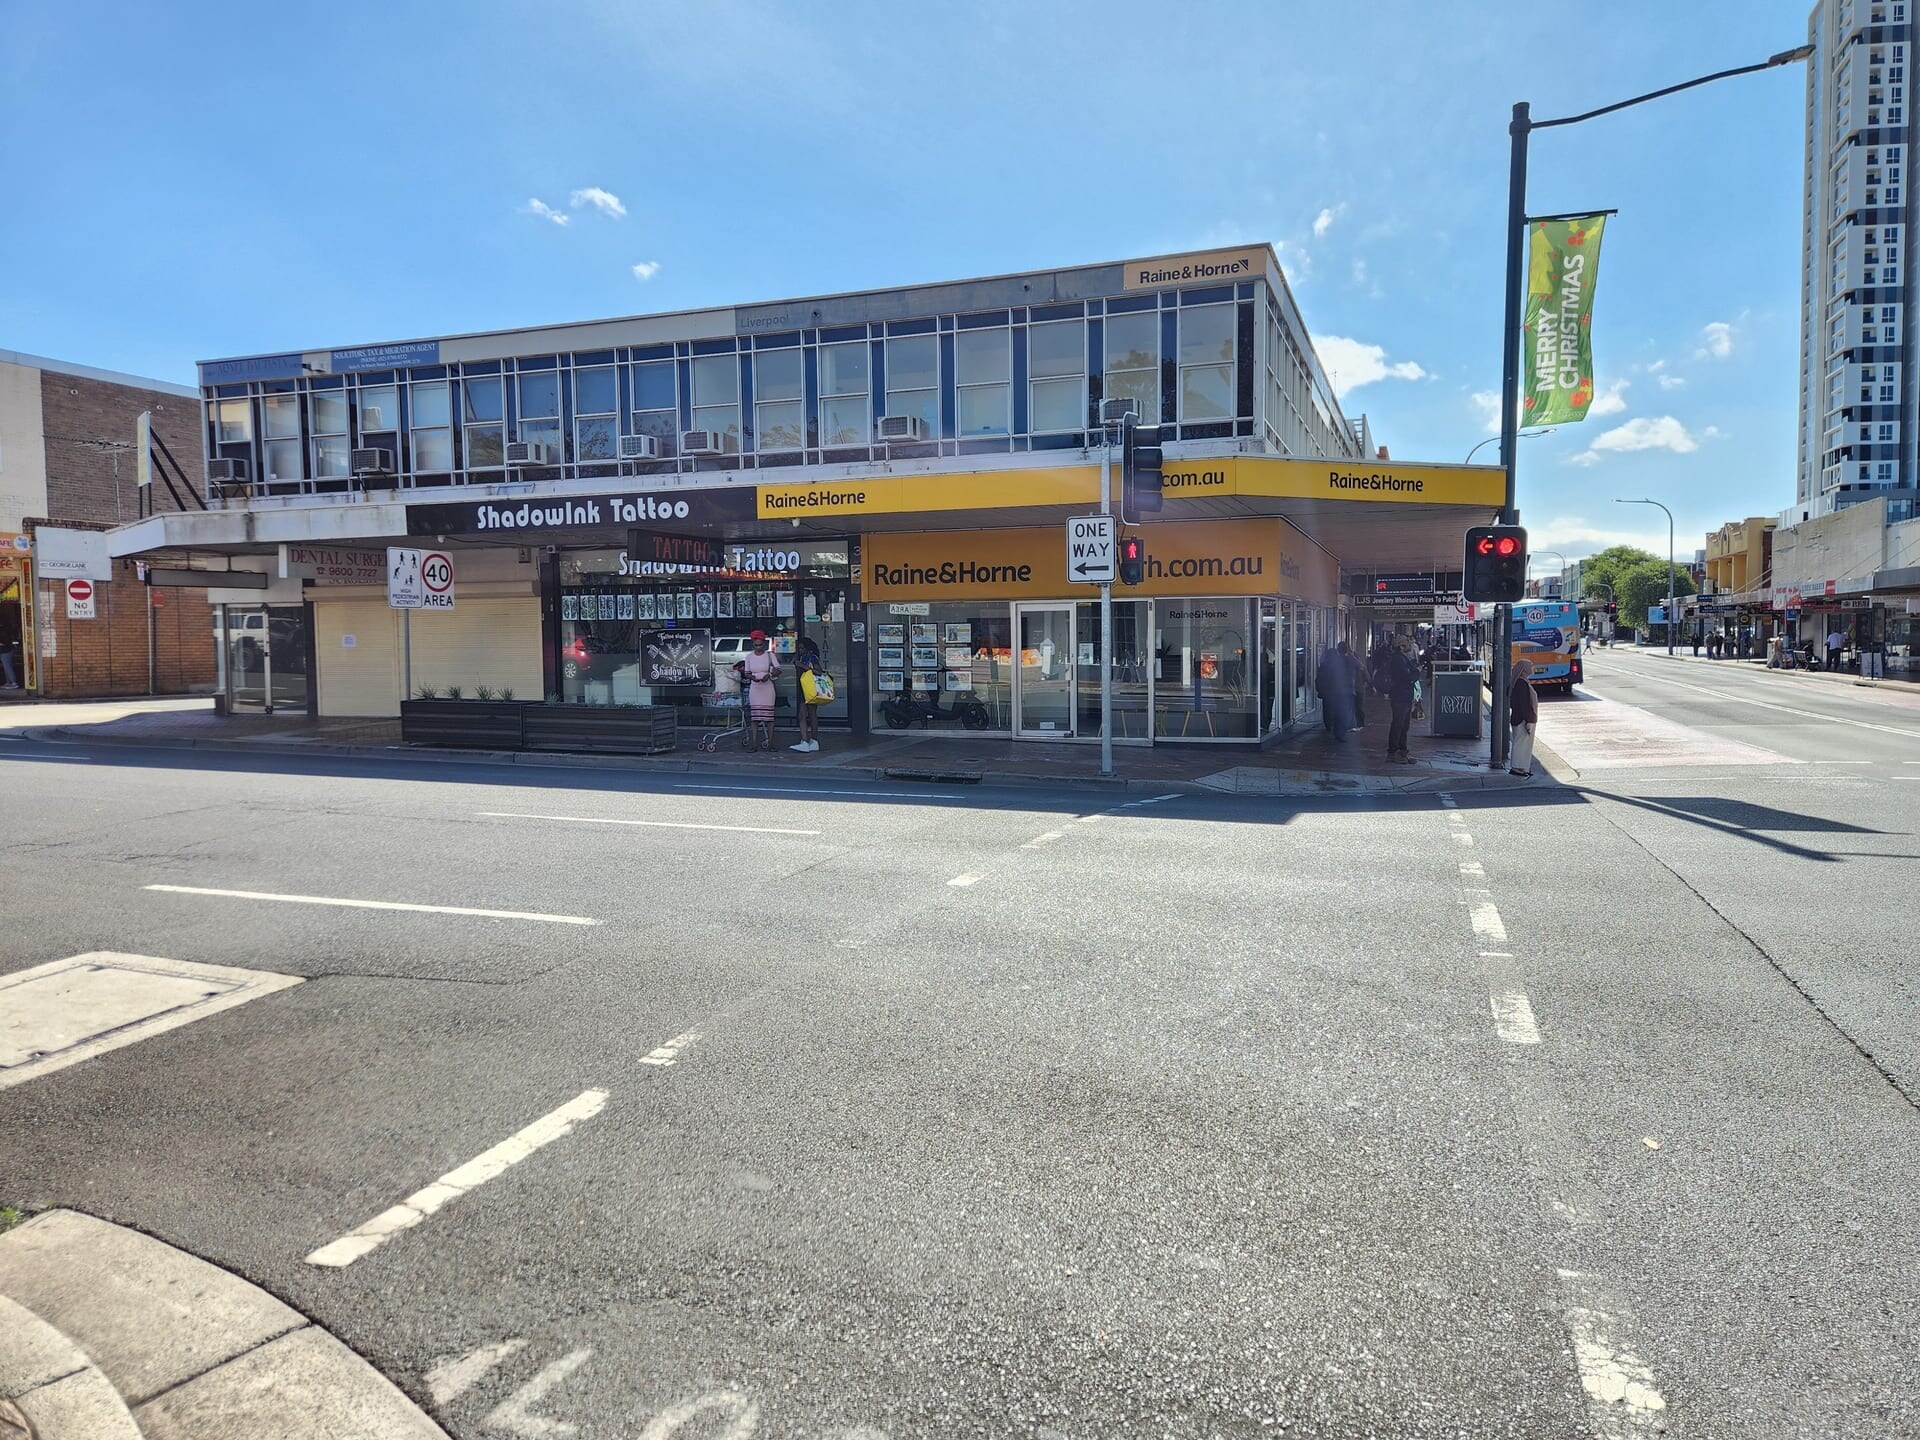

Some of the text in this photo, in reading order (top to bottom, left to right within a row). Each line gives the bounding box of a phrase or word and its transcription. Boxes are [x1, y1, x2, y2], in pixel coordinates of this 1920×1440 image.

[741, 313, 789, 328] Liverpool
[1558, 254, 1585, 389] CHRISTMAS
[1535, 308, 1558, 392] MERRY
[1329, 472, 1424, 492] Raine&Horne
[765, 491, 866, 508] Raine&Horne
[477, 497, 690, 530] ShadowInk Tattoo
[1075, 523, 1108, 537] ONE
[0, 539, 11, 547] AFE
[652, 536, 710, 562] TATTOO
[1073, 543, 1109, 558] WAY
[291, 549, 387, 567] DENTAL SURGE
[732, 548, 801, 571] Tattoo
[1143, 555, 1263, 578] h.com.au
[329, 567, 377, 577] 9600 7727
[426, 564, 450, 583] 40
[874, 562, 1032, 585] Raine&Horne
[424, 594, 454, 607] AREA
[1395, 595, 1418, 604] Wholesale
[1169, 610, 1228, 619] Raine&Horne
[1529, 612, 1541, 620] 40
[651, 663, 682, 680] Shadow
